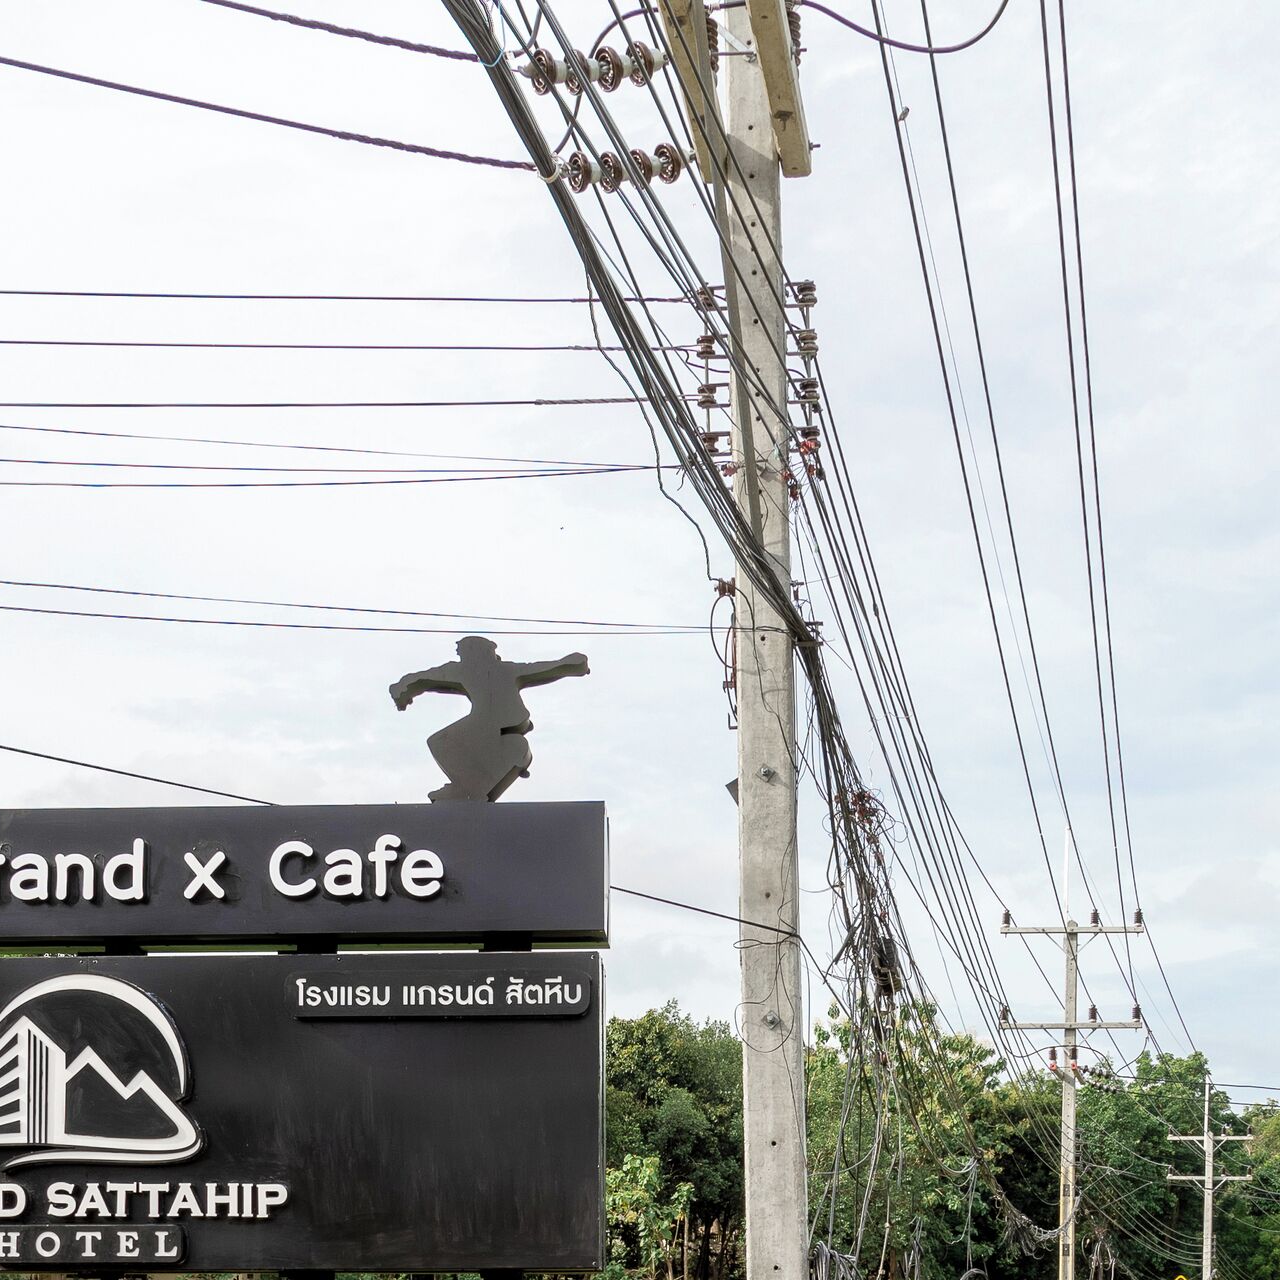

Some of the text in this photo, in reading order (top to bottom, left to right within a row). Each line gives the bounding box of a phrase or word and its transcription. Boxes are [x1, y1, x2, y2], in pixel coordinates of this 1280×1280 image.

[184, 850, 226, 900] x
[269, 833, 444, 897] Cafe
[295, 975, 582, 1007] โรงแรม แกรนด์ สัตหีบ
[46, 1180, 288, 1218] SATTAHIP
